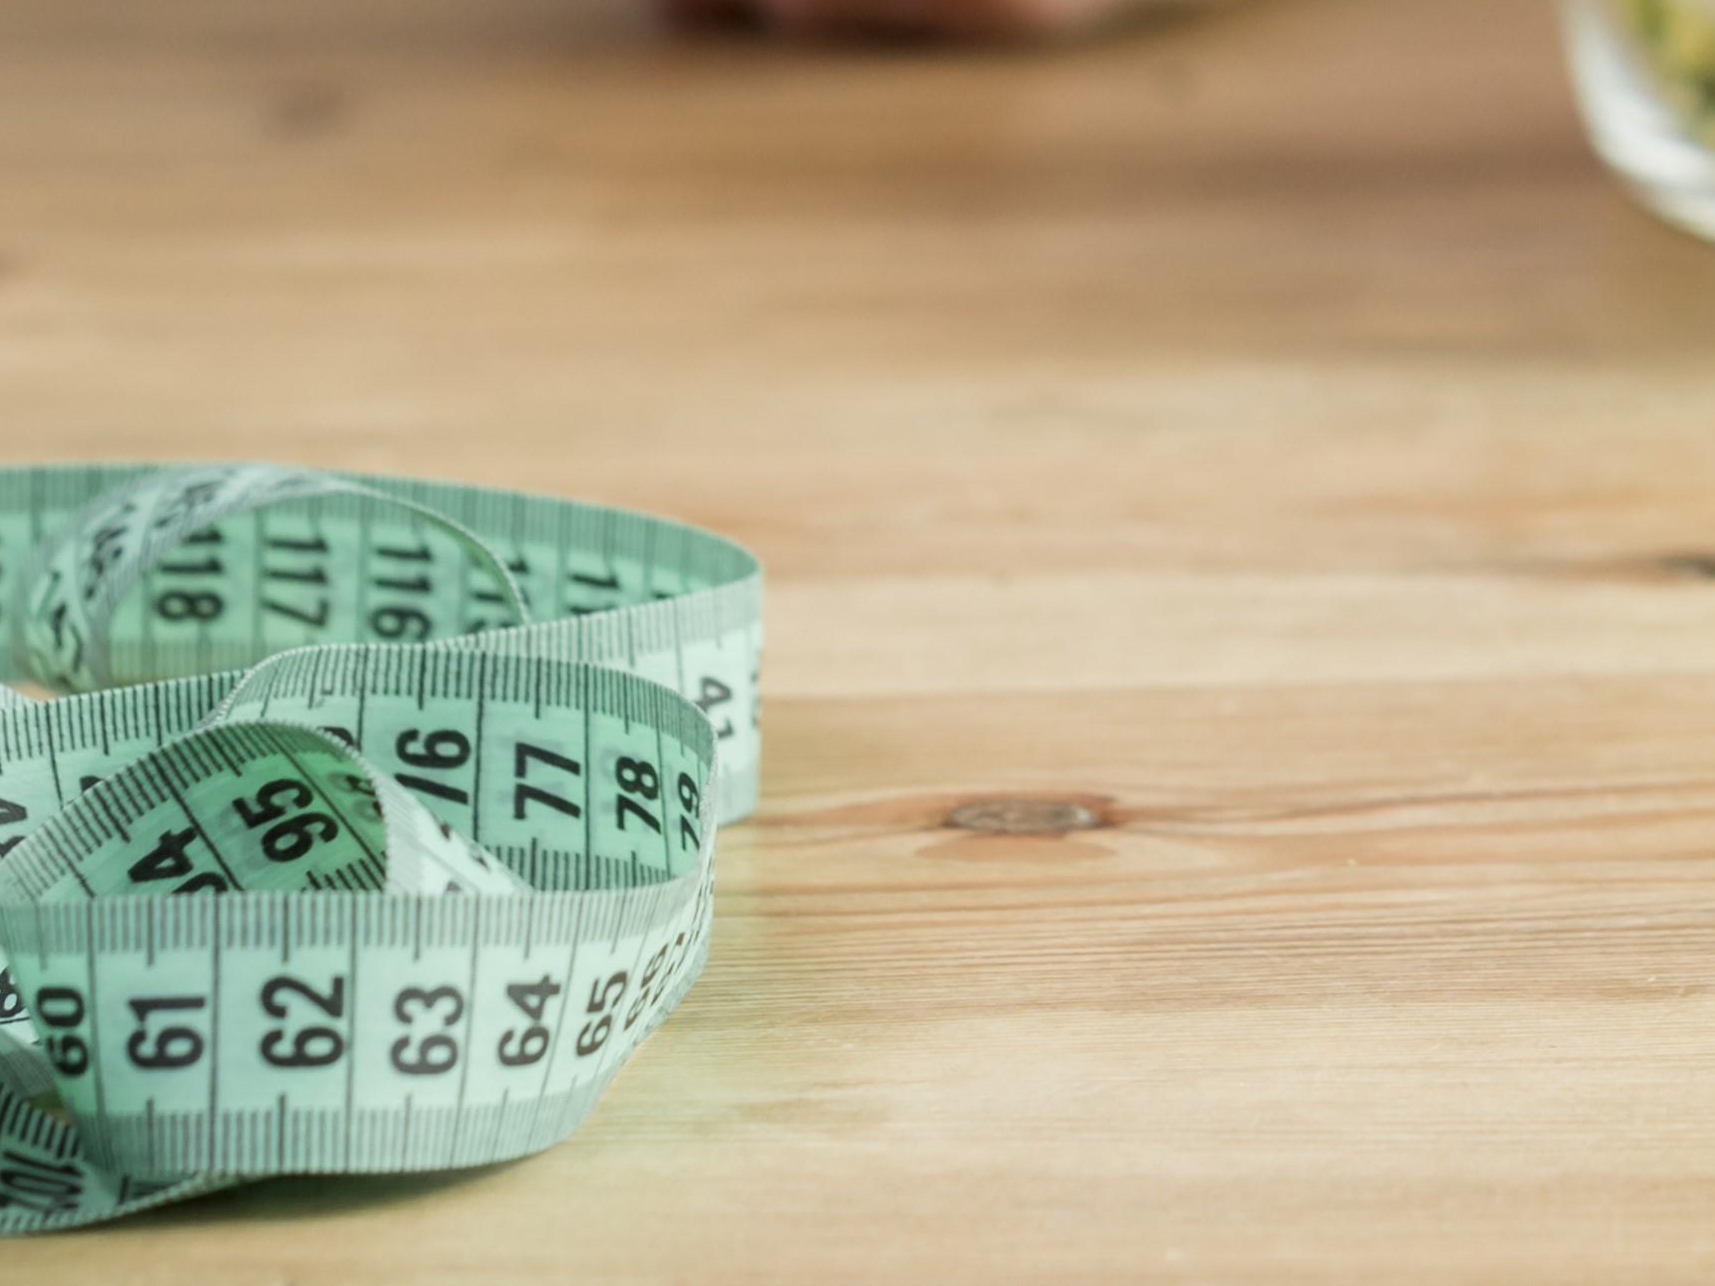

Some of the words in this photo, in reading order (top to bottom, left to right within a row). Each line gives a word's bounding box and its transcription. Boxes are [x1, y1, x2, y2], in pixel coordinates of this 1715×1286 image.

[154, 526, 224, 622] 118
[262, 536, 328, 628] 117
[370, 545, 433, 645] 116
[231, 778, 340, 864] 95
[514, 742, 581, 820] 77
[616, 756, 663, 835] 78
[37, 986, 89, 1077] 60
[127, 996, 206, 1070] 61
[260, 975, 344, 1069] 62
[390, 984, 464, 1076] 63
[497, 974, 561, 1068] 64
[576, 970, 628, 1057] 65
